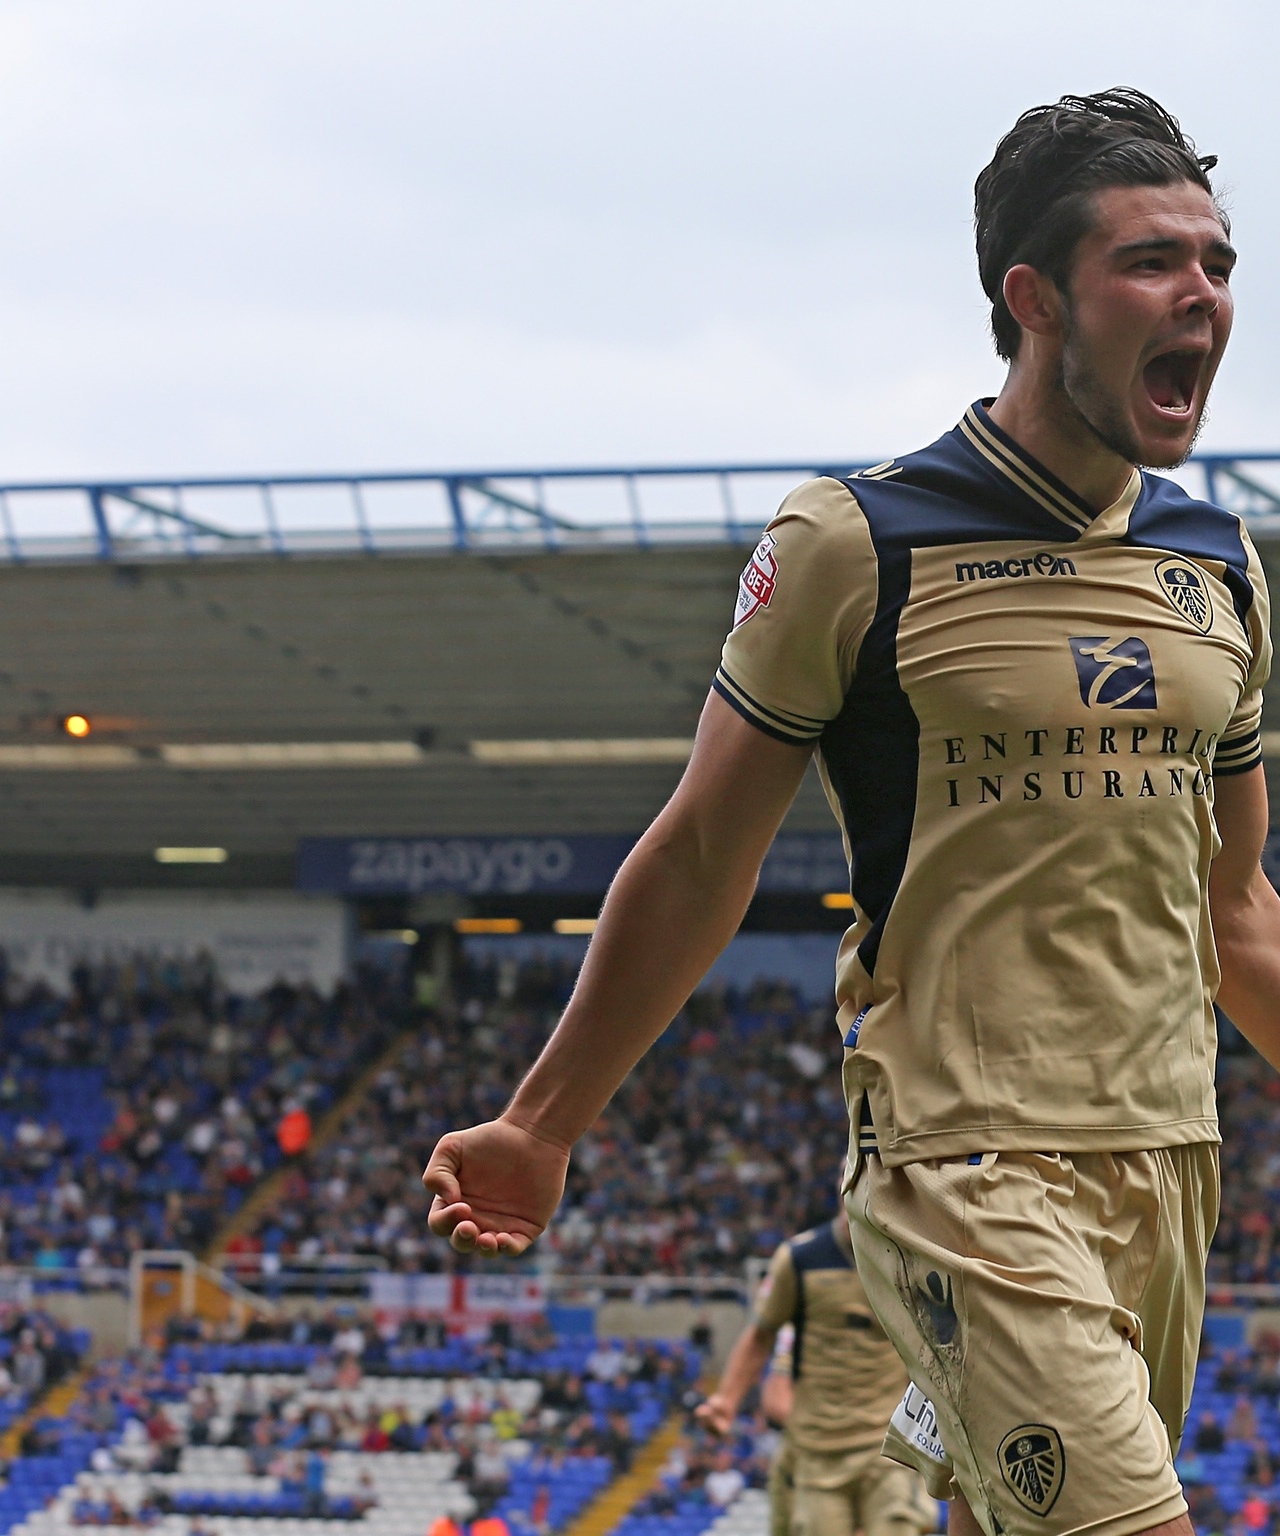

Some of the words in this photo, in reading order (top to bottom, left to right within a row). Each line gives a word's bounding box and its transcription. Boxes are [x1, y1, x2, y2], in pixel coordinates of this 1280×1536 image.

[747, 566, 771, 598] BET
[955, 552, 1078, 583] macron
[945, 726, 1217, 765] ENTERPRIS
